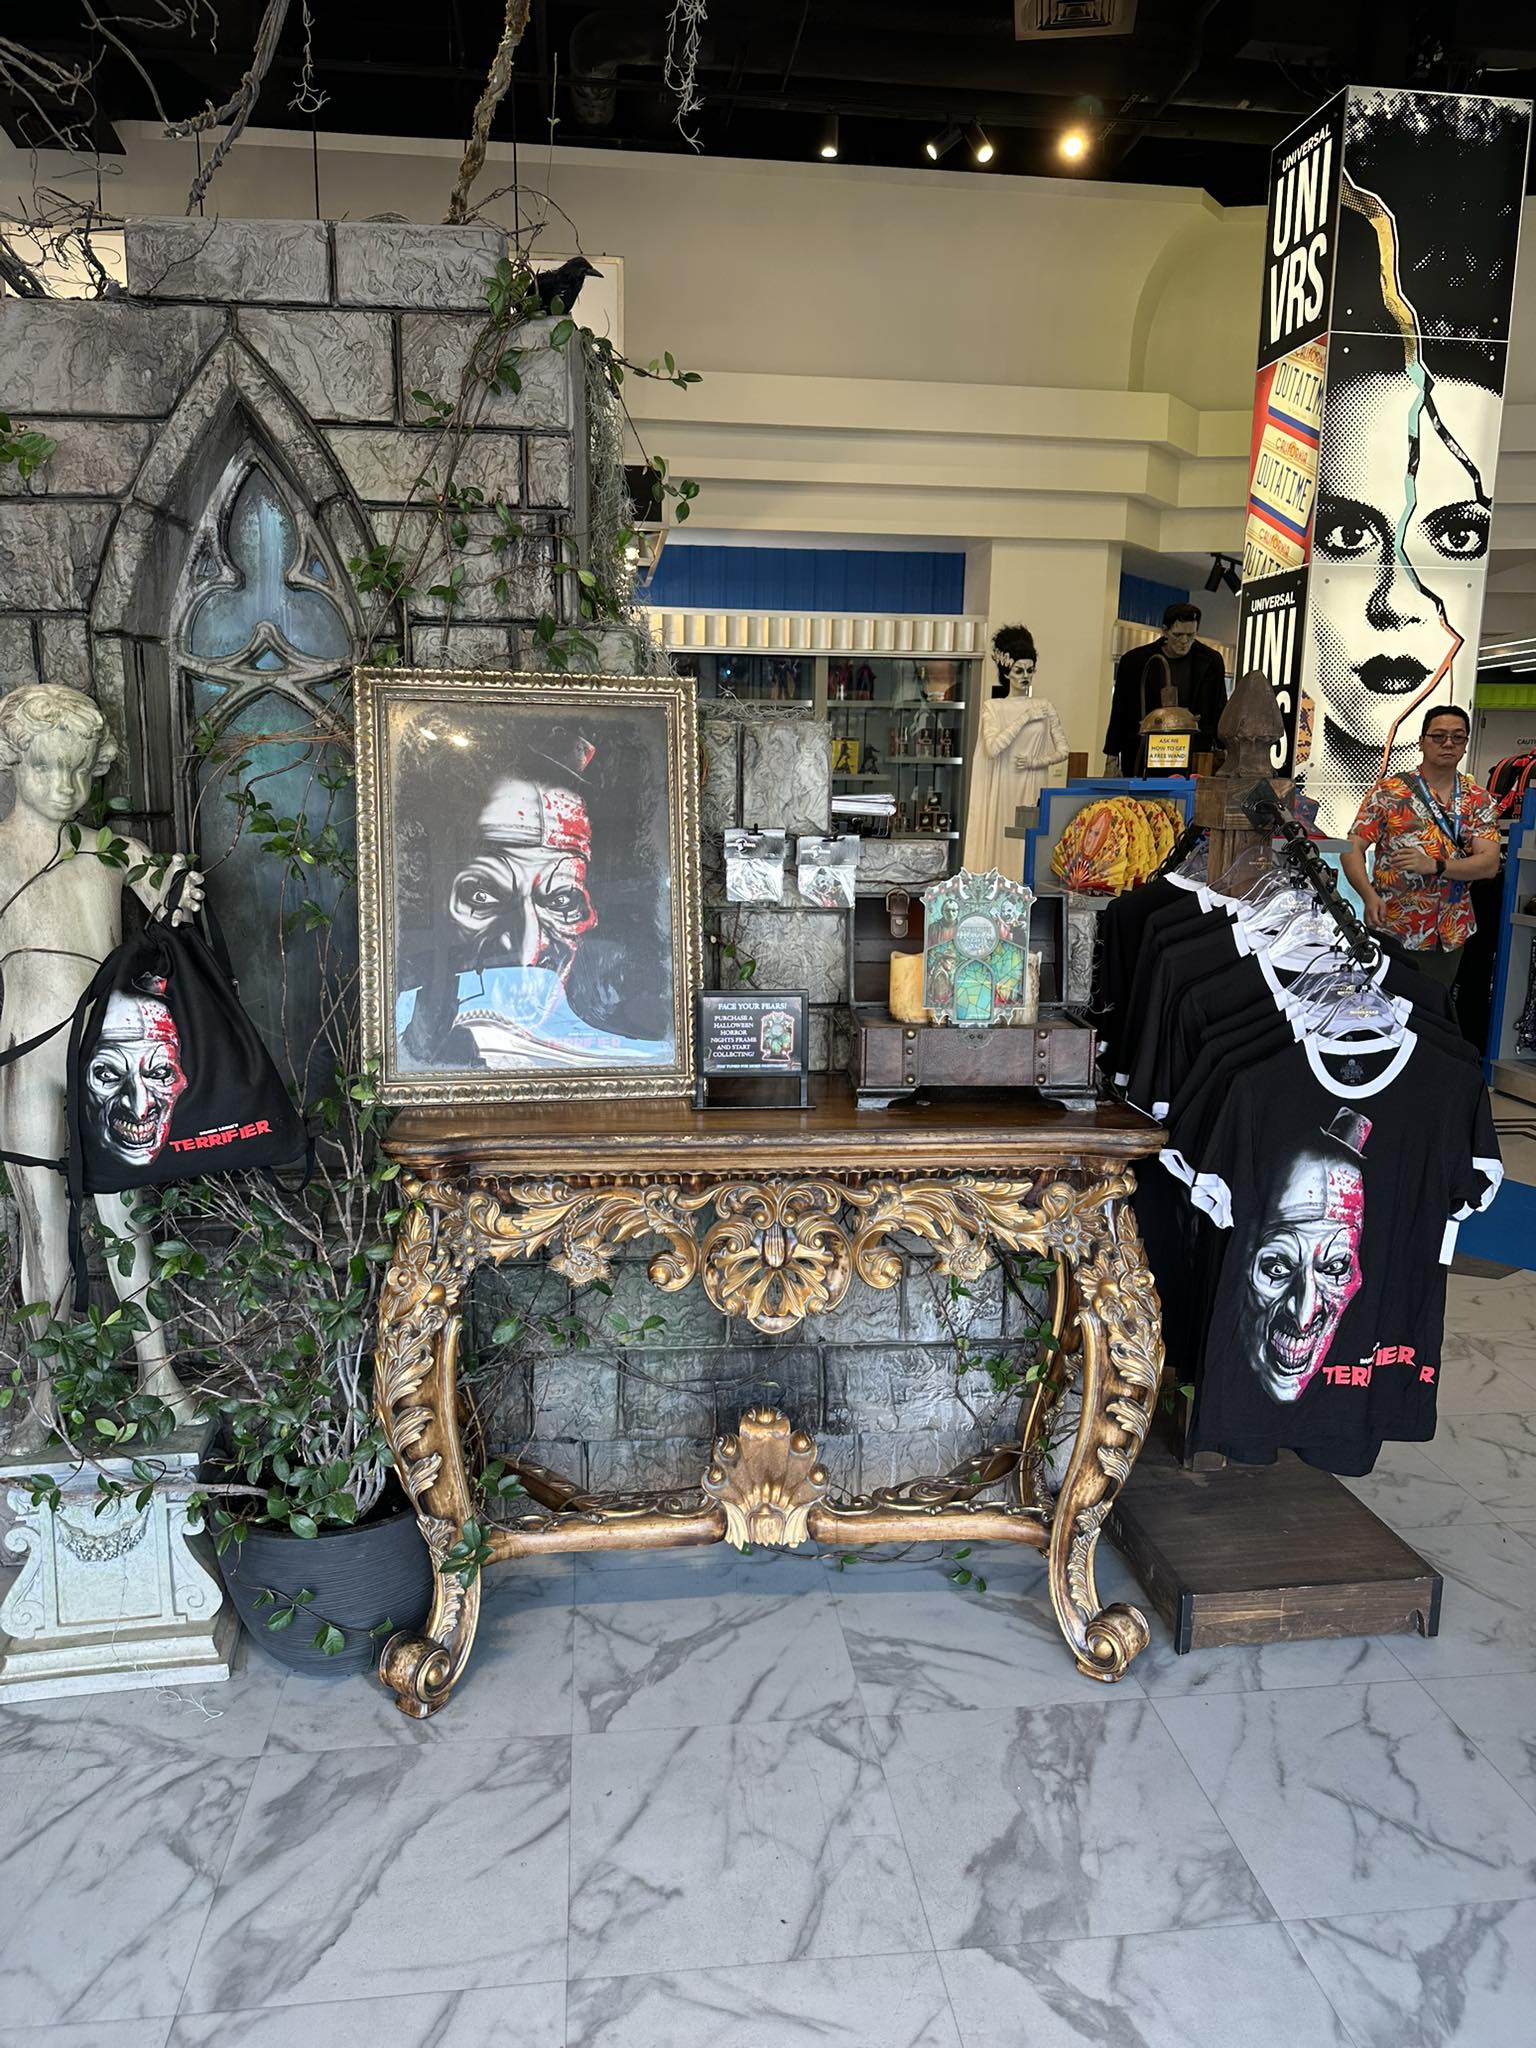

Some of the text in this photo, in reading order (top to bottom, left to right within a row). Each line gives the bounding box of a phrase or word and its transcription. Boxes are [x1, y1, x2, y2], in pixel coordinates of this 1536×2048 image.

[1282, 124, 1331, 172] UNIVERSAL
[1273, 138, 1332, 256] UNI
[1271, 233, 1327, 344] VRS
[1257, 453, 1312, 513] OUTATIME
[1251, 591, 1295, 612] UNIVERSAL
[718, 1002, 788, 1010] FACE YOUR FEARS!
[169, 1119, 272, 1152] TERRIFIER
